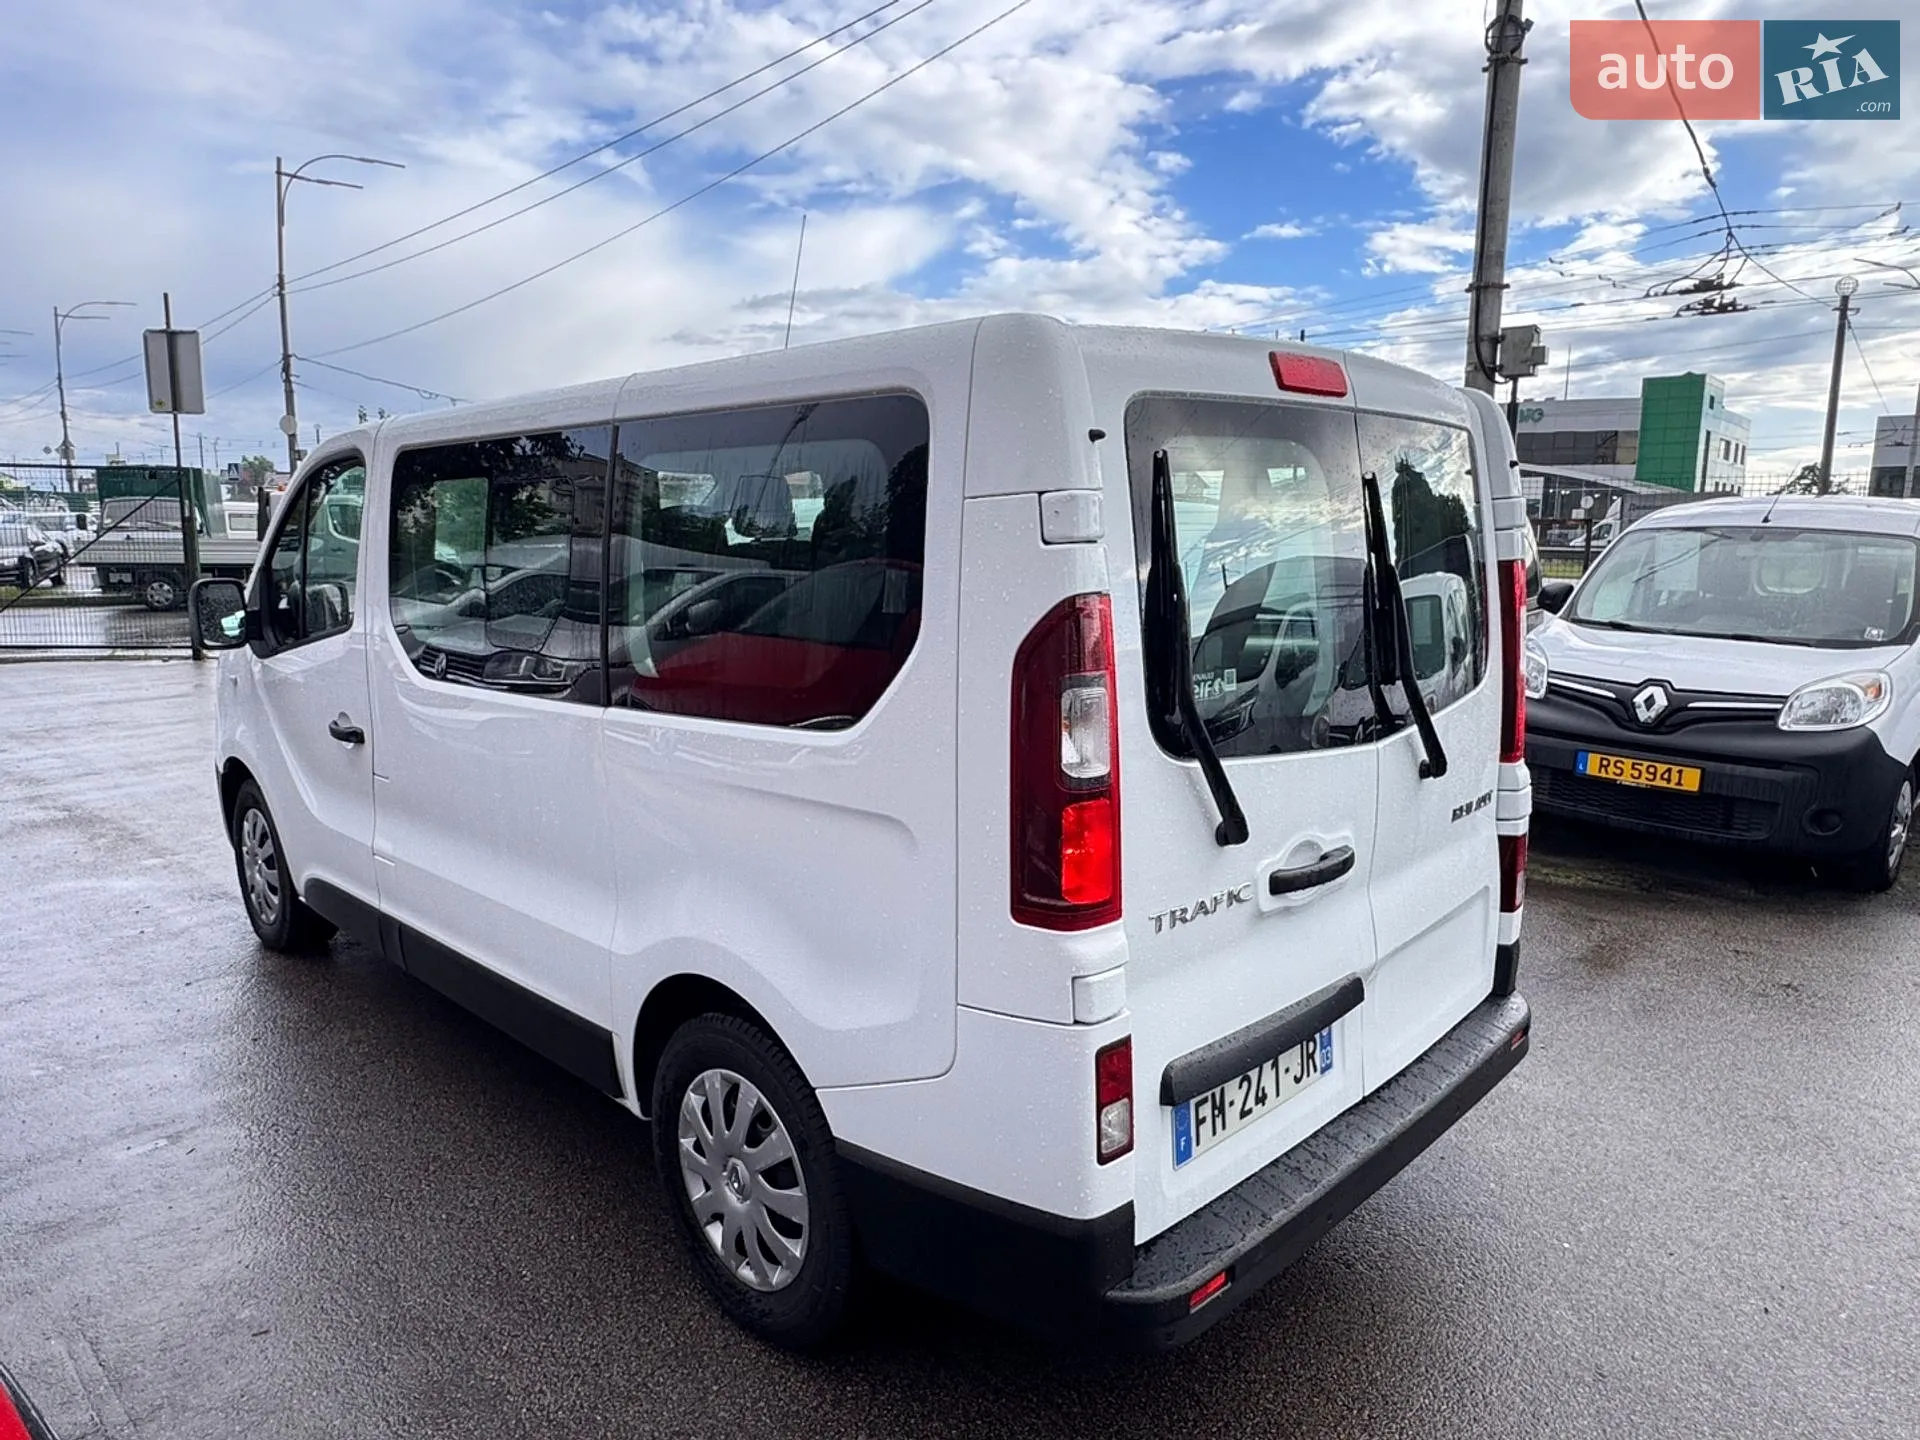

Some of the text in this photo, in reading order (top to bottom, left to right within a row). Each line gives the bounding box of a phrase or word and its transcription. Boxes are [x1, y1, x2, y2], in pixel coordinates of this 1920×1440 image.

[1598, 757, 1625, 777] RS
[1630, 762, 1684, 787] 5941
[1148, 882, 1252, 935] TRAFIC
[1194, 1034, 1318, 1147] FM-241-JR
[1180, 1136, 1187, 1152] F
